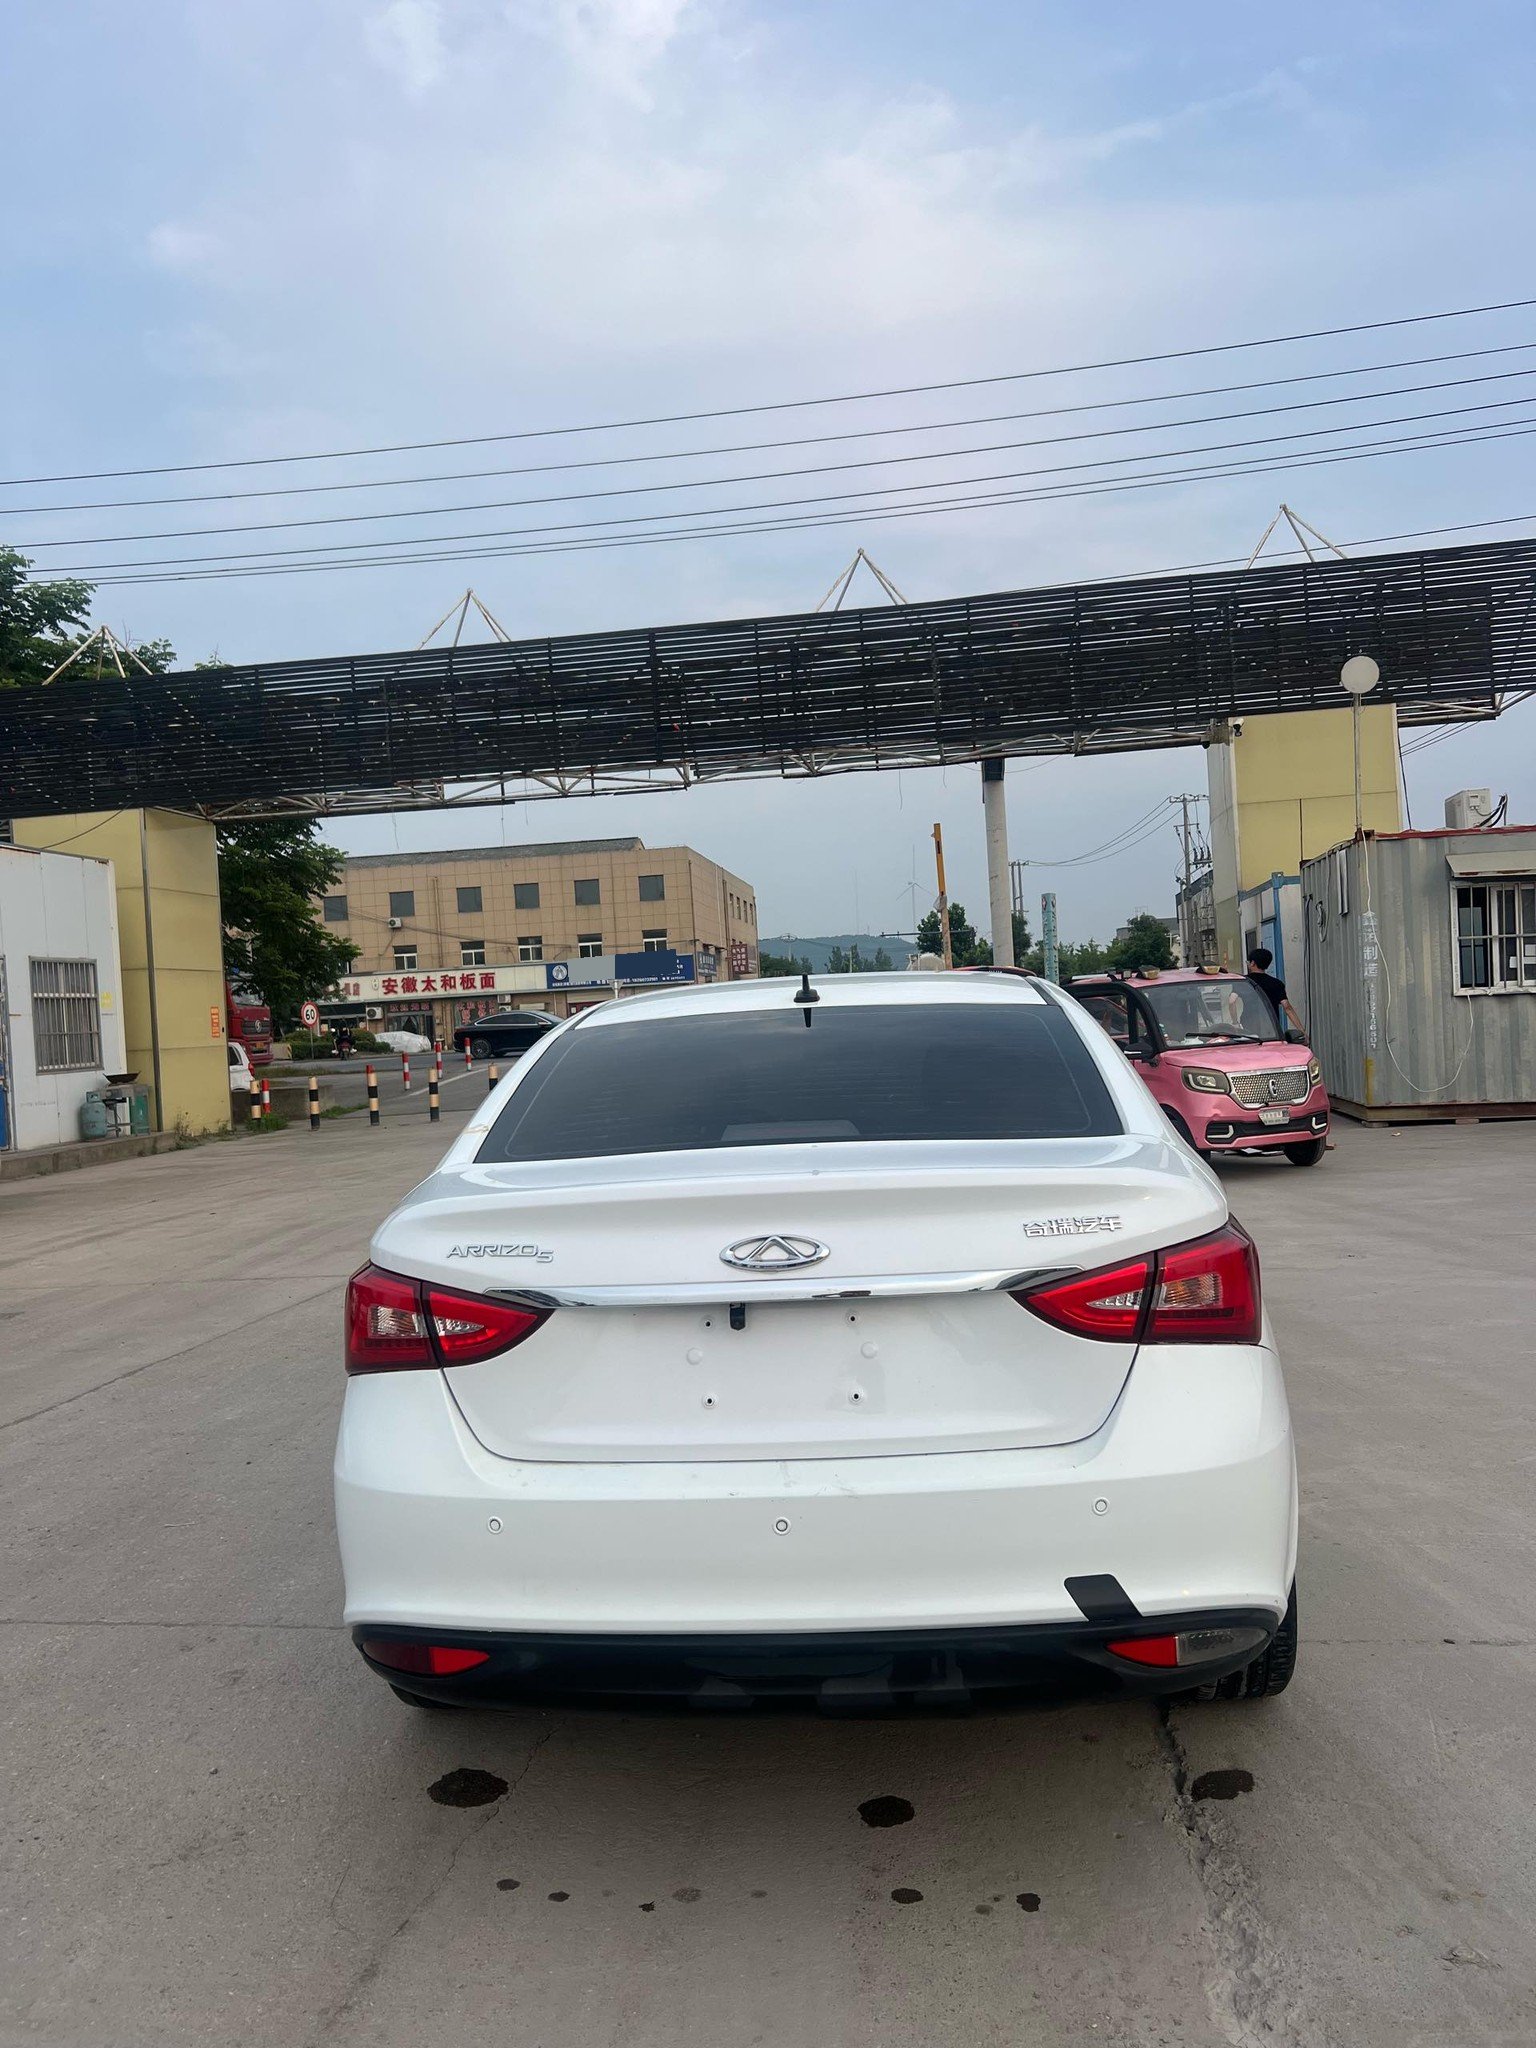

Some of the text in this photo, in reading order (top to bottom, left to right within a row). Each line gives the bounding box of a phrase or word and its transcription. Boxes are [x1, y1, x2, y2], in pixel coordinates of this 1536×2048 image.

[382, 972, 497, 995] 安徽太和板面
[305, 1009, 315, 1020] 60
[1023, 1215, 1123, 1238] 奇瑞汽车
